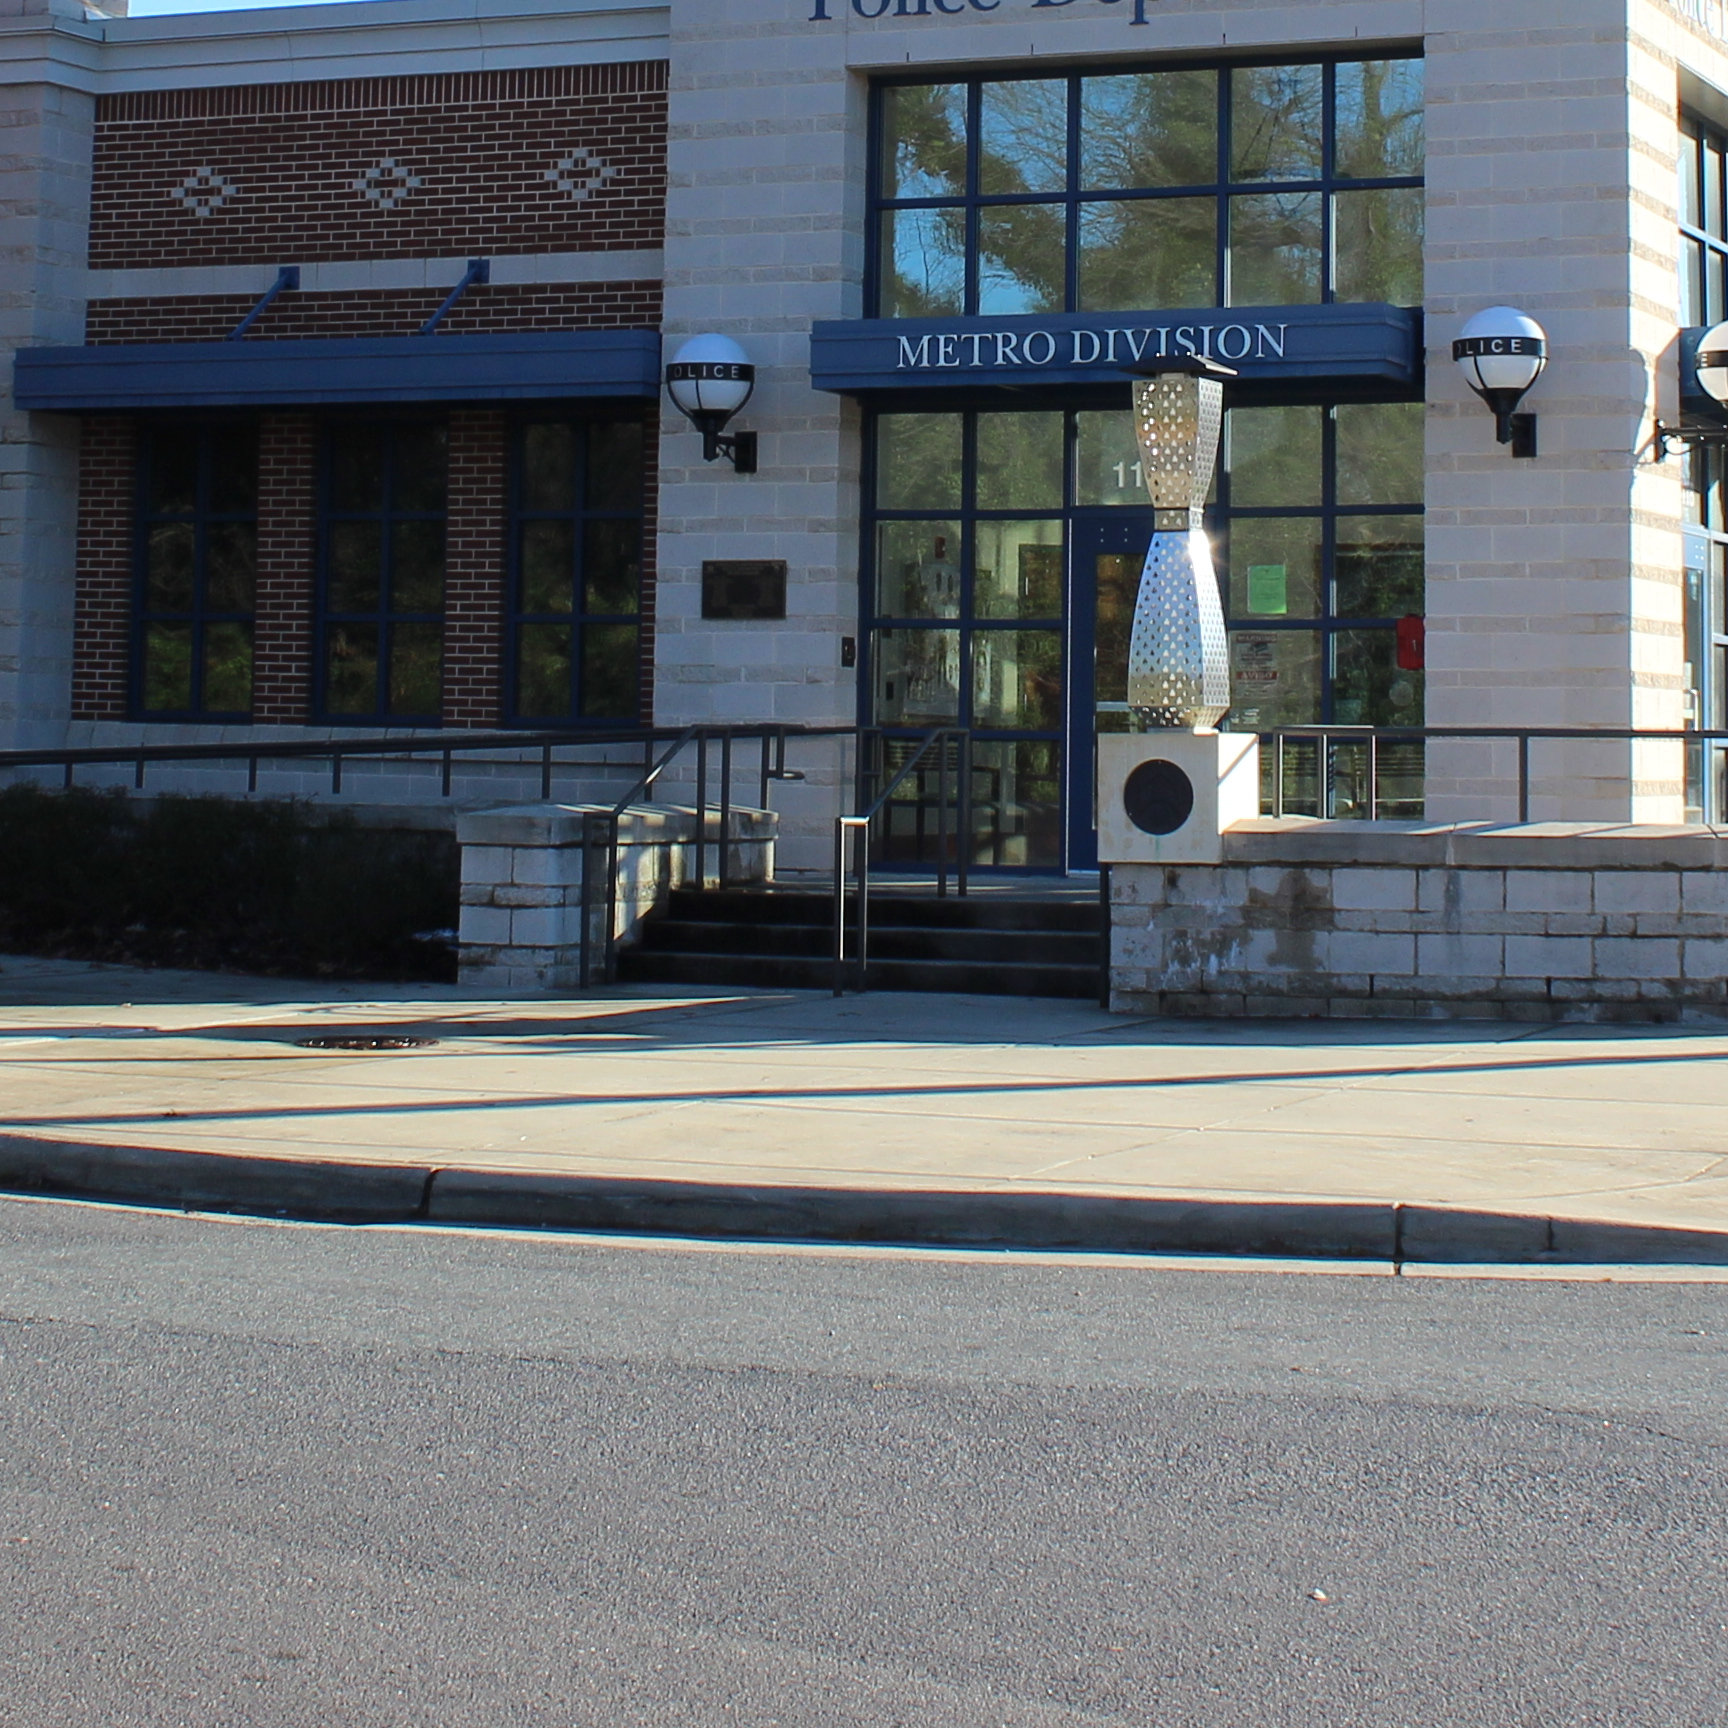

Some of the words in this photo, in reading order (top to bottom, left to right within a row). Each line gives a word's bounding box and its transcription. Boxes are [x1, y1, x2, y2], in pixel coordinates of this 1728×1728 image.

[896, 329, 1057, 369] METRO
[1070, 323, 1289, 363] DIVISION
[674, 364, 740, 379] OLICE
